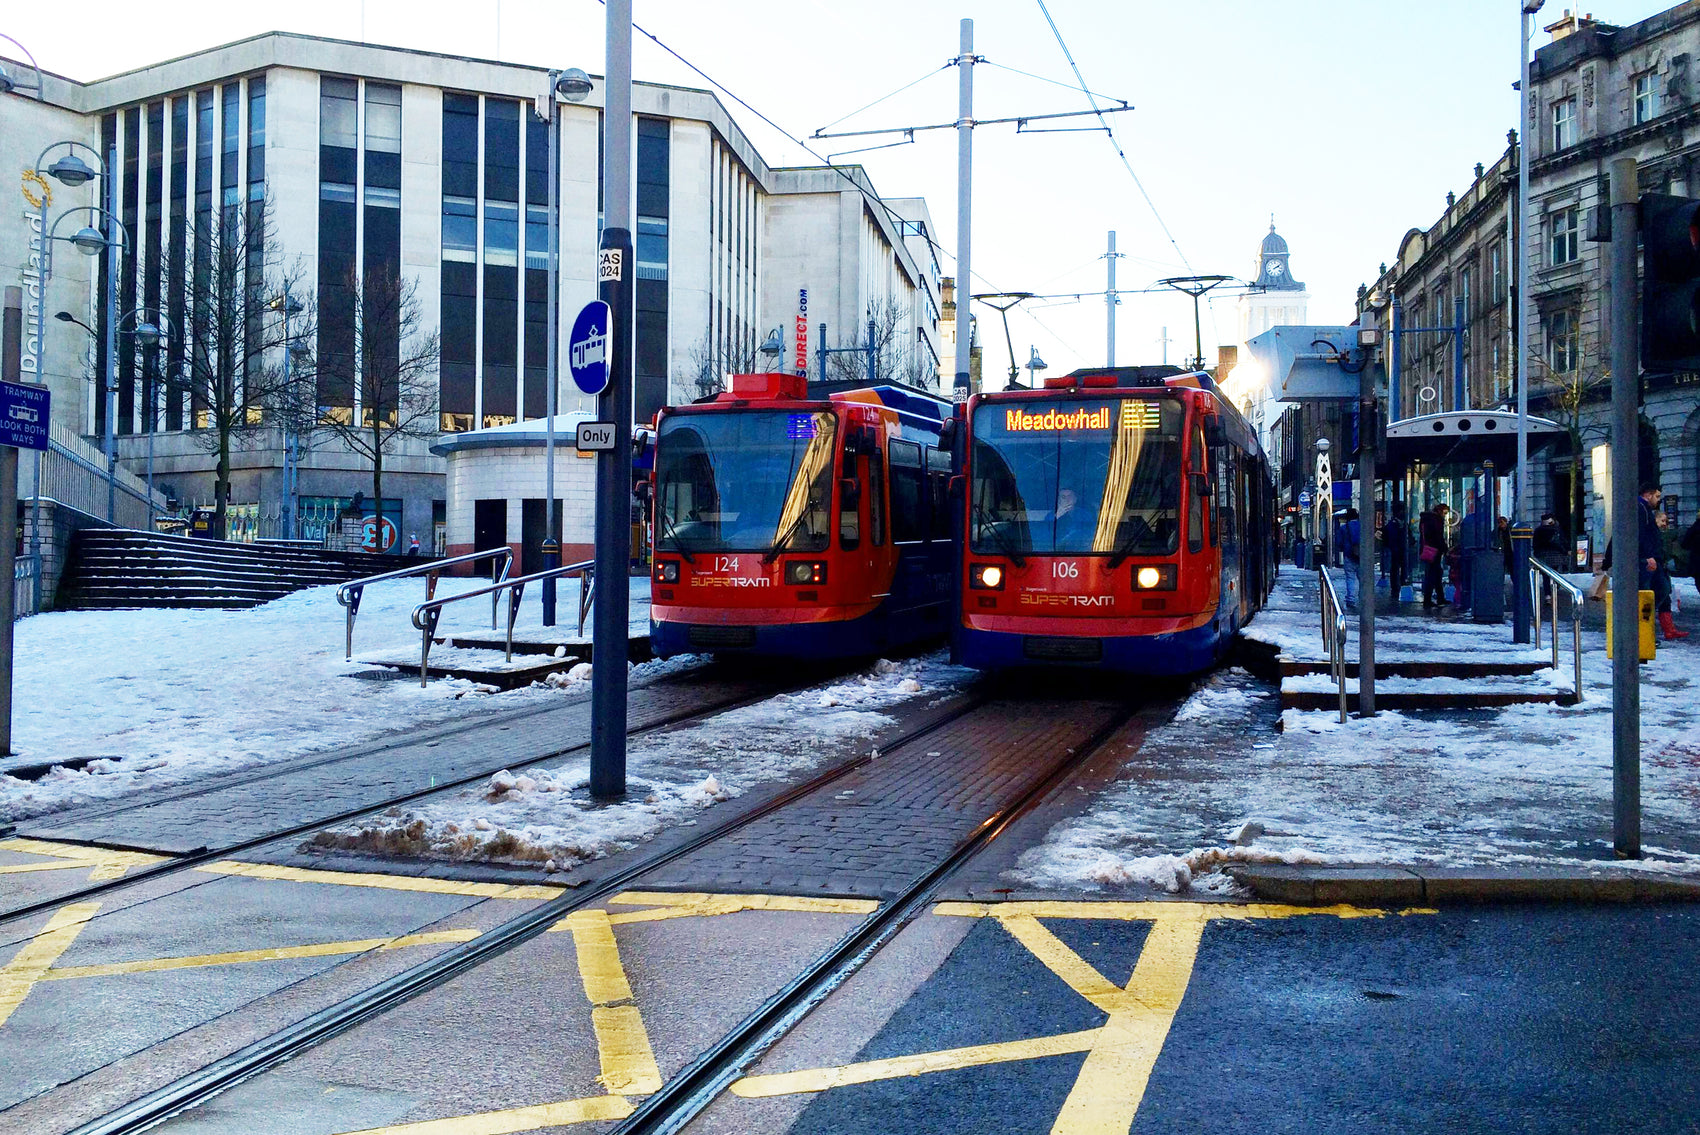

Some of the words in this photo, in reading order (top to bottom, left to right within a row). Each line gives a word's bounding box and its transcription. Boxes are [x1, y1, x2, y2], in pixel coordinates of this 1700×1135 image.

[600, 265, 620, 278] 024
[4, 385, 44, 401] TRAMWAY
[1006, 407, 1110, 431] Meadowhall
[0, 419, 22, 432] LOOK
[24, 423, 46, 436] BOTH
[11, 433, 34, 446] WAYS
[582, 429, 610, 445] Only
[714, 556, 740, 573] 124
[1052, 561, 1079, 579] 106
[690, 576, 770, 588] SUPERTRAM
[1020, 593, 1115, 607] SUPERTRAM
